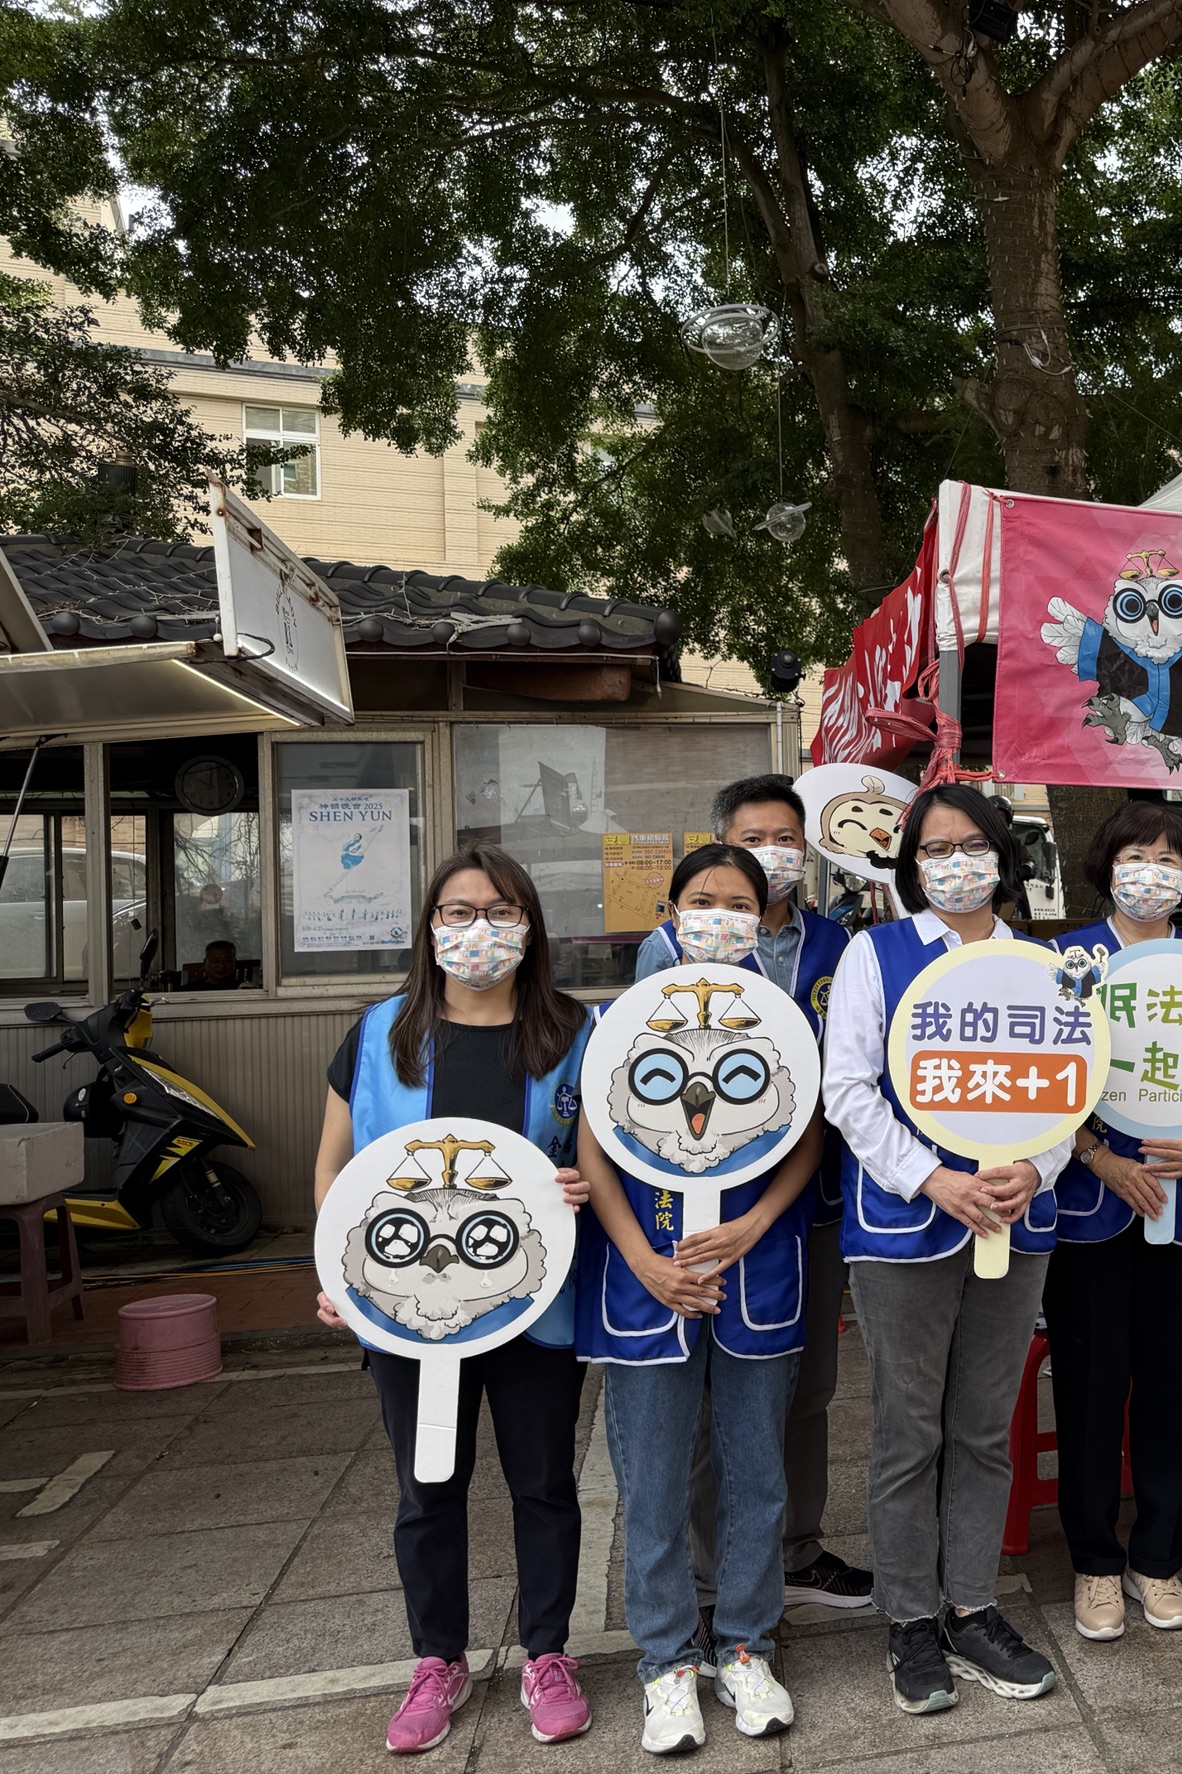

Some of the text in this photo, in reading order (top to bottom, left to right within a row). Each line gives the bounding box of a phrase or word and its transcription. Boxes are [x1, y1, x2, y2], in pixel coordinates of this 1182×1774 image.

[309, 811, 392, 822] SHEN YUN
[911, 1001, 1093, 1046] 我的司法
[916, 1057, 1078, 1107] 我來+1
[1101, 1090, 1127, 1102] zen
[655, 1189, 674, 1231] 法院
